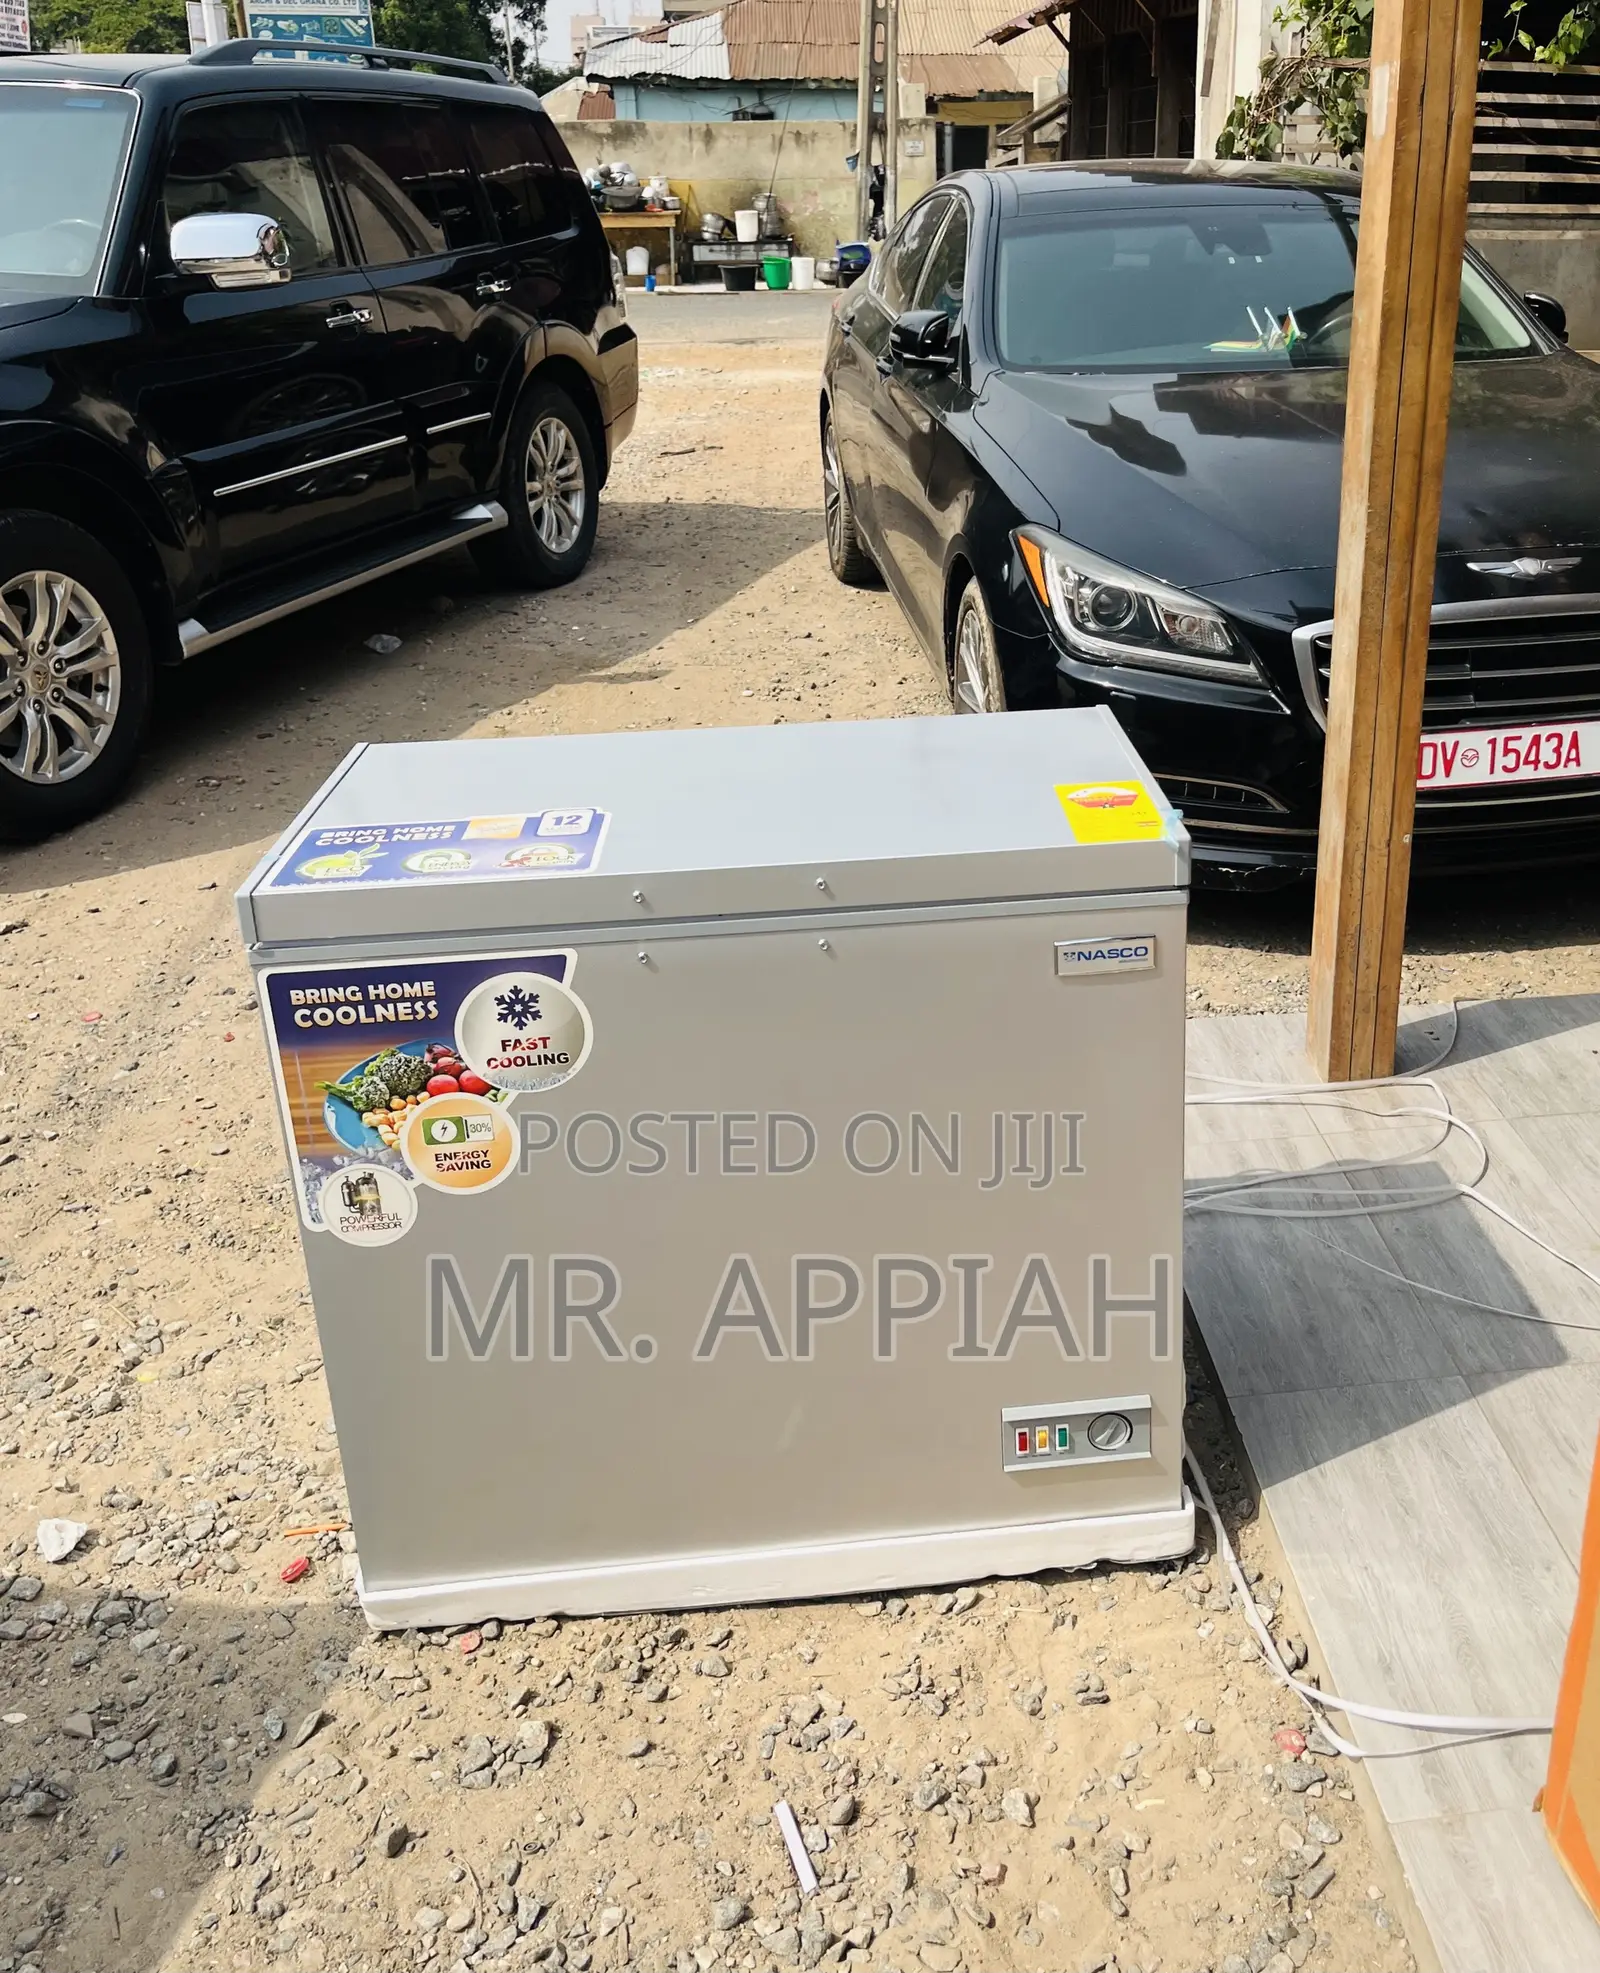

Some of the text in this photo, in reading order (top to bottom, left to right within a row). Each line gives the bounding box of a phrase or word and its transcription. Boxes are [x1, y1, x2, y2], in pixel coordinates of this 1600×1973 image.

[1417, 730, 1582, 780] DV 1543A
[551, 815, 583, 826] 12
[315, 831, 453, 846] COOLNESS
[319, 825, 456, 839] BRING HOME
[1077, 945, 1149, 961] NASCO
[289, 980, 436, 1006] BRING HOME
[294, 1000, 440, 1028] COOLNESS
[501, 1036, 551, 1052] FAST
[486, 1052, 570, 1069] COOLING
[469, 1122, 492, 1133] 30%
[434, 1149, 489, 1162] ENERGY
[436, 1159, 492, 1172] SAVING
[339, 1212, 403, 1225] POWERFUL
[340, 1221, 402, 1233] COMPRESSOR
